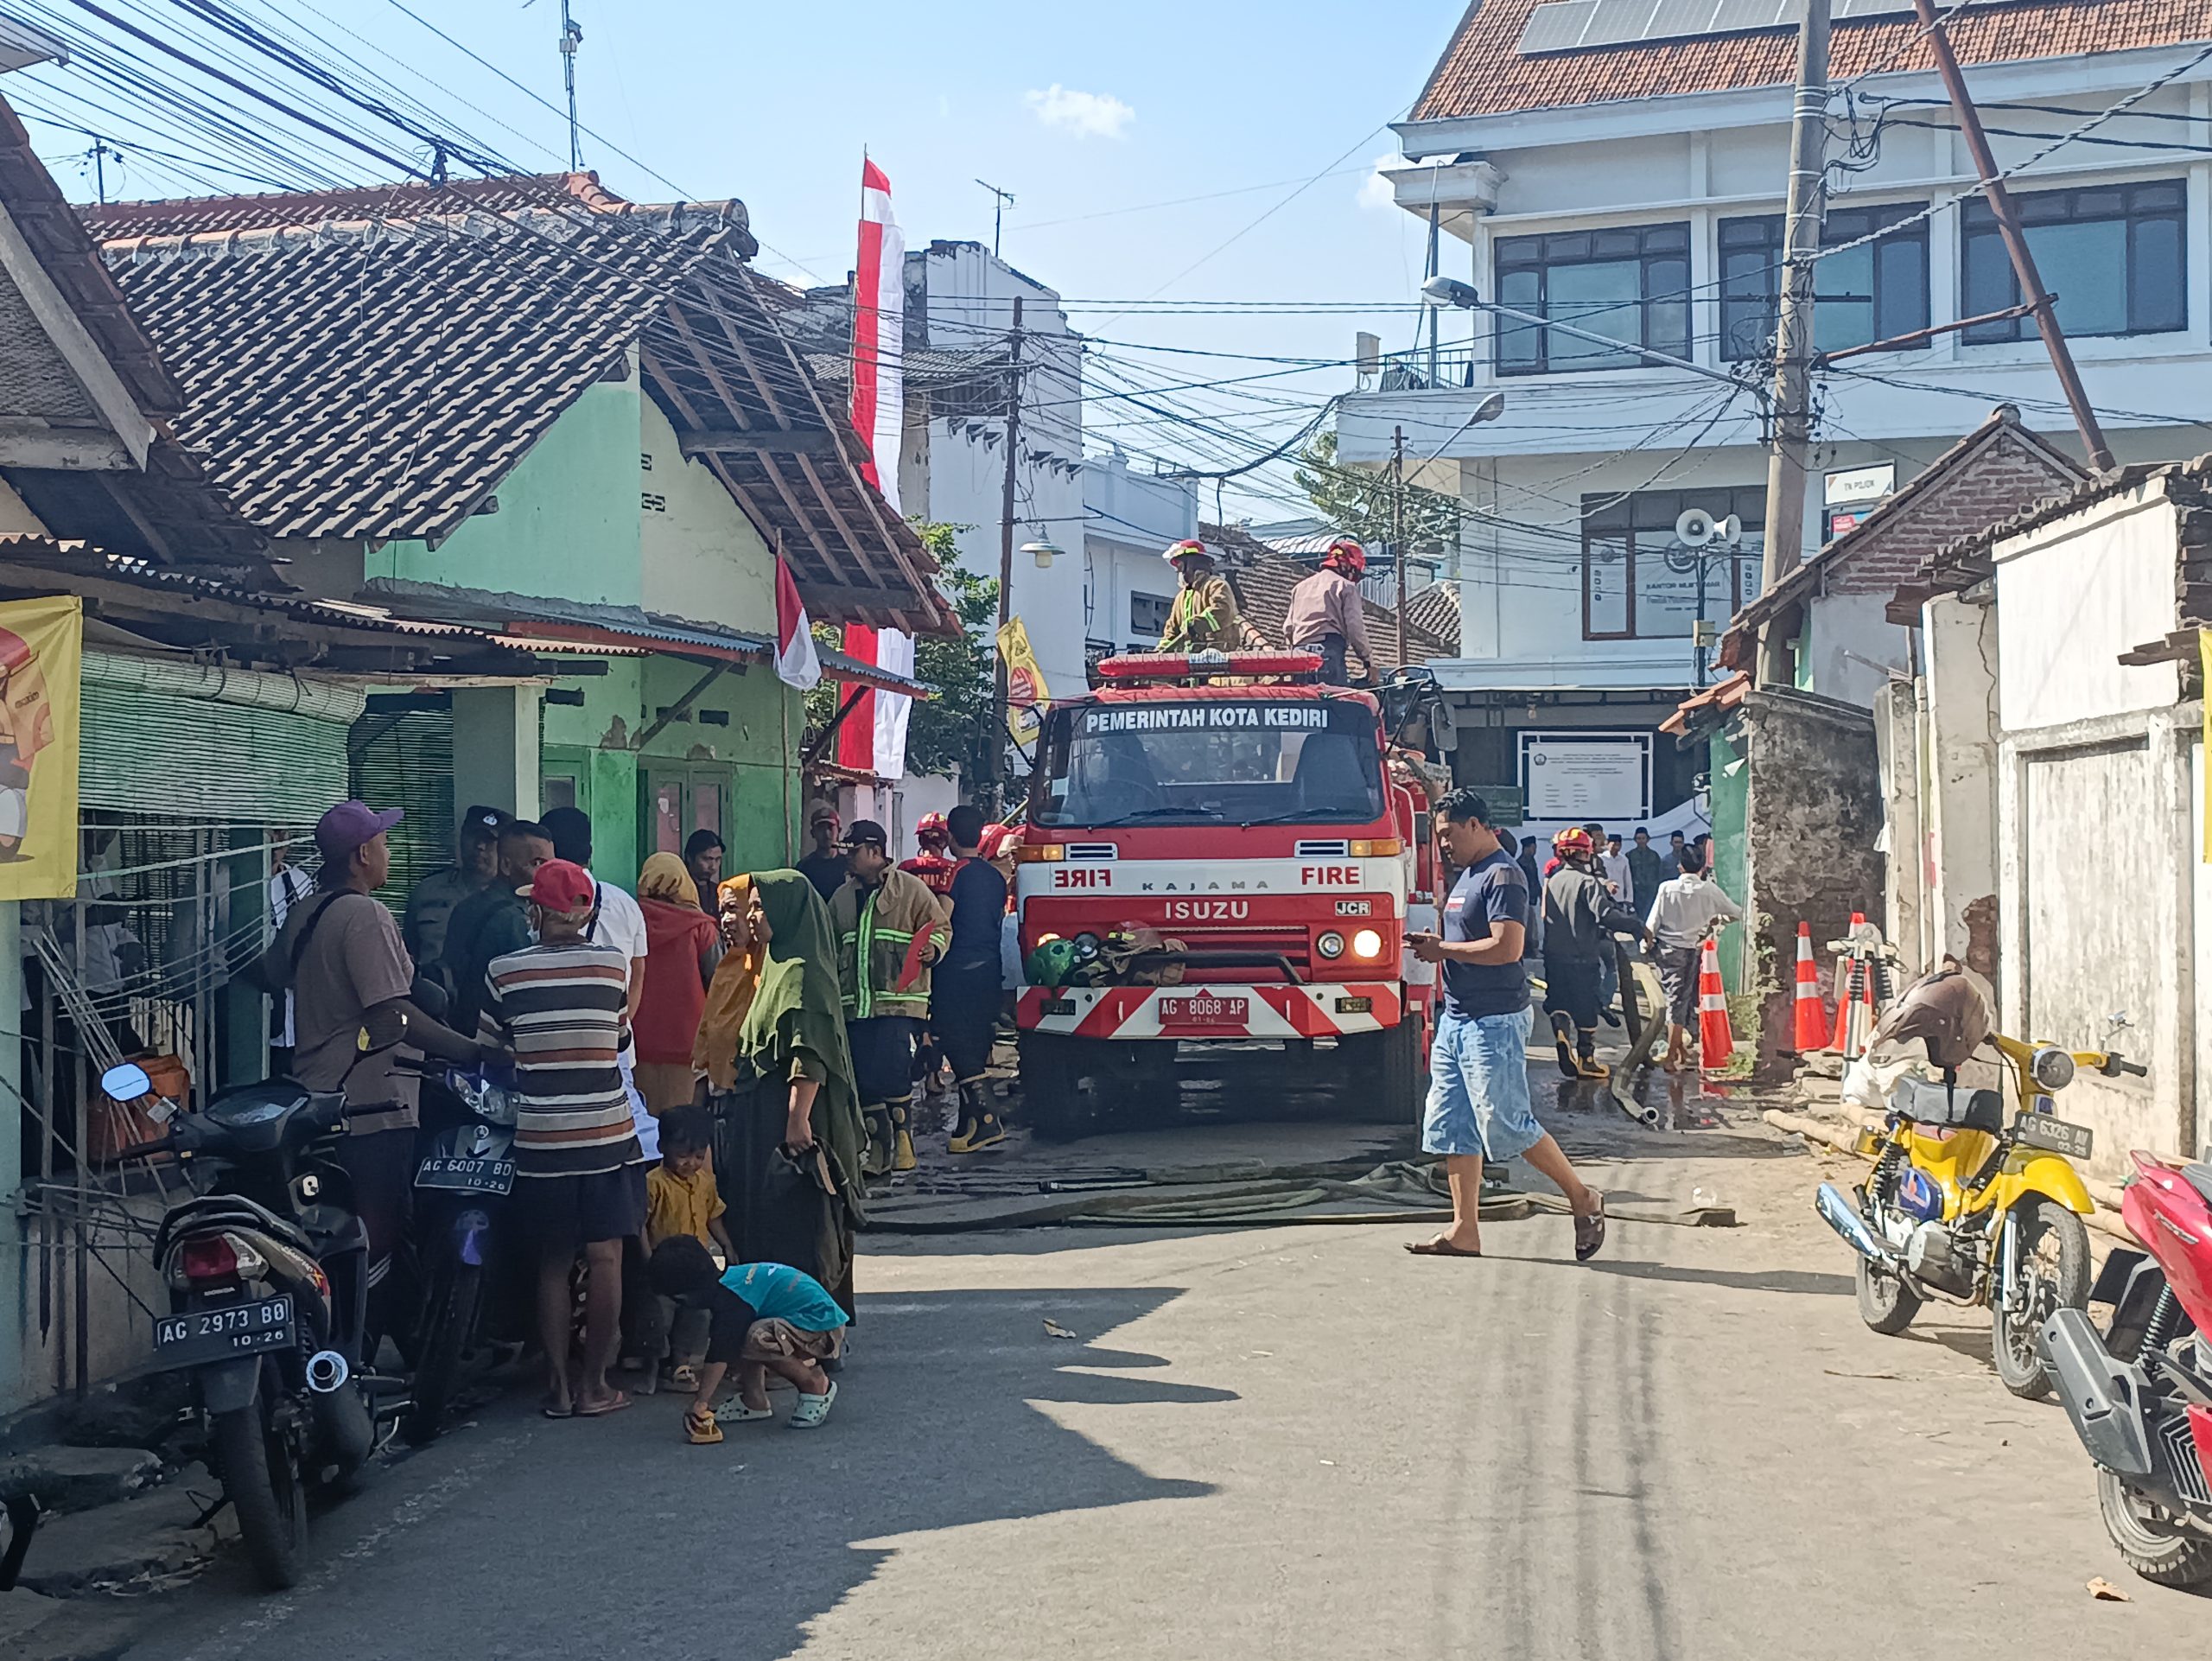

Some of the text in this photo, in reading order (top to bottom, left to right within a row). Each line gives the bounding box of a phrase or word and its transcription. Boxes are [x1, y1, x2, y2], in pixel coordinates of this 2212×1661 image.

[1086, 708, 1328, 733] PEMERINTAH KOTA KEDIRI
[1141, 880, 1269, 891] KAJAMA
[1300, 866, 1360, 886] FIRE
[1165, 901, 1249, 920] ISUZU
[1337, 901, 1370, 915] JCR
[1161, 999, 1245, 1015] AG 8068 AP
[2019, 1115, 2037, 1132] AG
[2039, 1119, 2070, 1141] 6326
[423, 1160, 442, 1172] AG
[447, 1159, 485, 1174] 6007
[162, 1321, 188, 1344] AG
[198, 1309, 249, 1335] 2973
